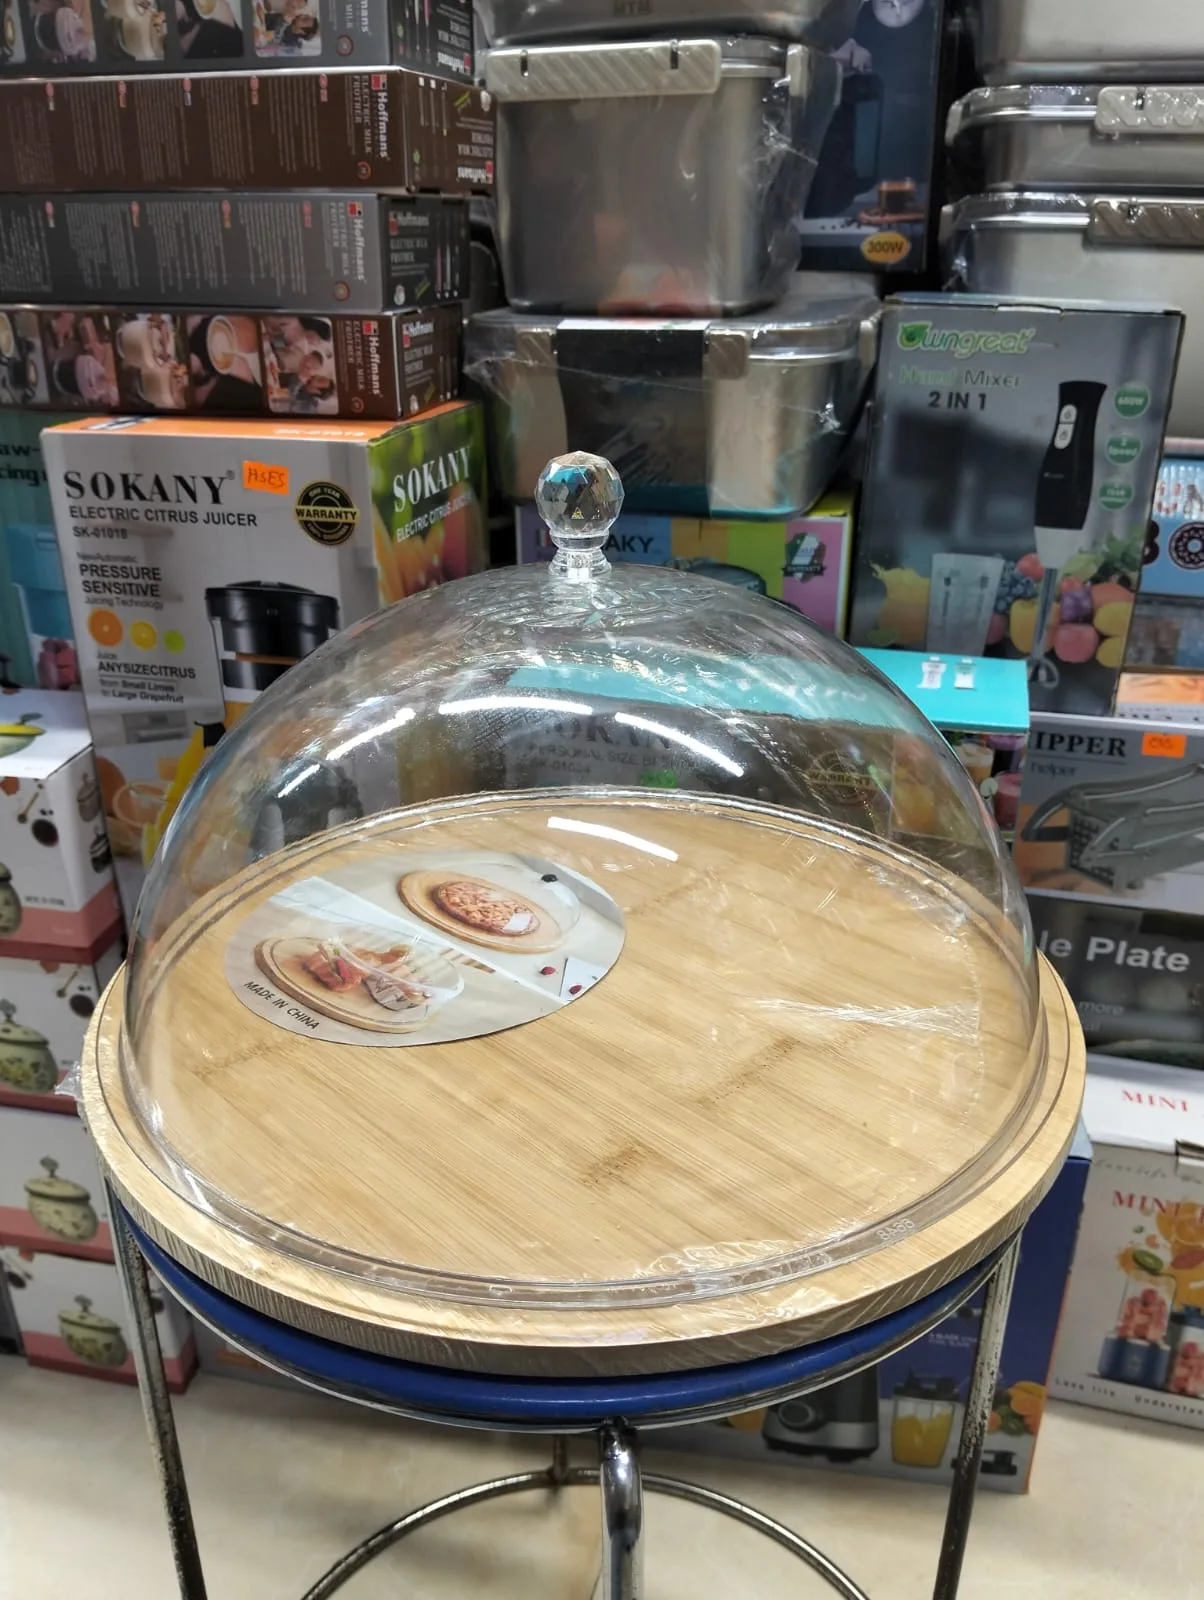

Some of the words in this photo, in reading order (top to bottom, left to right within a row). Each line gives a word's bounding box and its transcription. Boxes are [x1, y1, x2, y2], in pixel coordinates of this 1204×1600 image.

[352, 75, 362, 123] FROTHER
[361, 75, 370, 125] ELECTRIC
[377, 91, 389, 158] Hoffmans
[363, 128, 372, 153] MILK
[354, 219, 366, 280] Hoffmans
[368, 336, 380, 394] Hoffmans
[928, 389, 941, 409] 2
[947, 391, 970, 410] IN
[977, 391, 988, 411] 1
[63, 470, 227, 506] SOKANY
[393, 446, 470, 513] SOKANY
[69, 505, 140, 522] ELECTRIC
[144, 508, 199, 525] CITRUS
[202, 510, 258, 528] JUICER
[296, 508, 358, 521] WARRANTY
[396, 514, 429, 543] ELECTRIC
[79, 563, 162, 581] PRESSURE
[82, 580, 160, 598] SENSITIVE
[115, 598, 164, 611] Technology
[98, 661, 196, 679] ANYSIZECITRUS
[112, 690, 138, 701] Large
[139, 691, 184, 704] Grapefruit
[121, 680, 146, 690] Small
[1034, 731, 1128, 759] IPPER
[1030, 761, 1078, 778] helper
[1085, 936, 1190, 973] Plate
[244, 981, 275, 1001] MADE
[272, 997, 288, 1009] IN
[286, 1007, 319, 1030] CHINA
[1121, 1088, 1188, 1113] MINI
[1113, 1189, 1184, 1217] MINI
